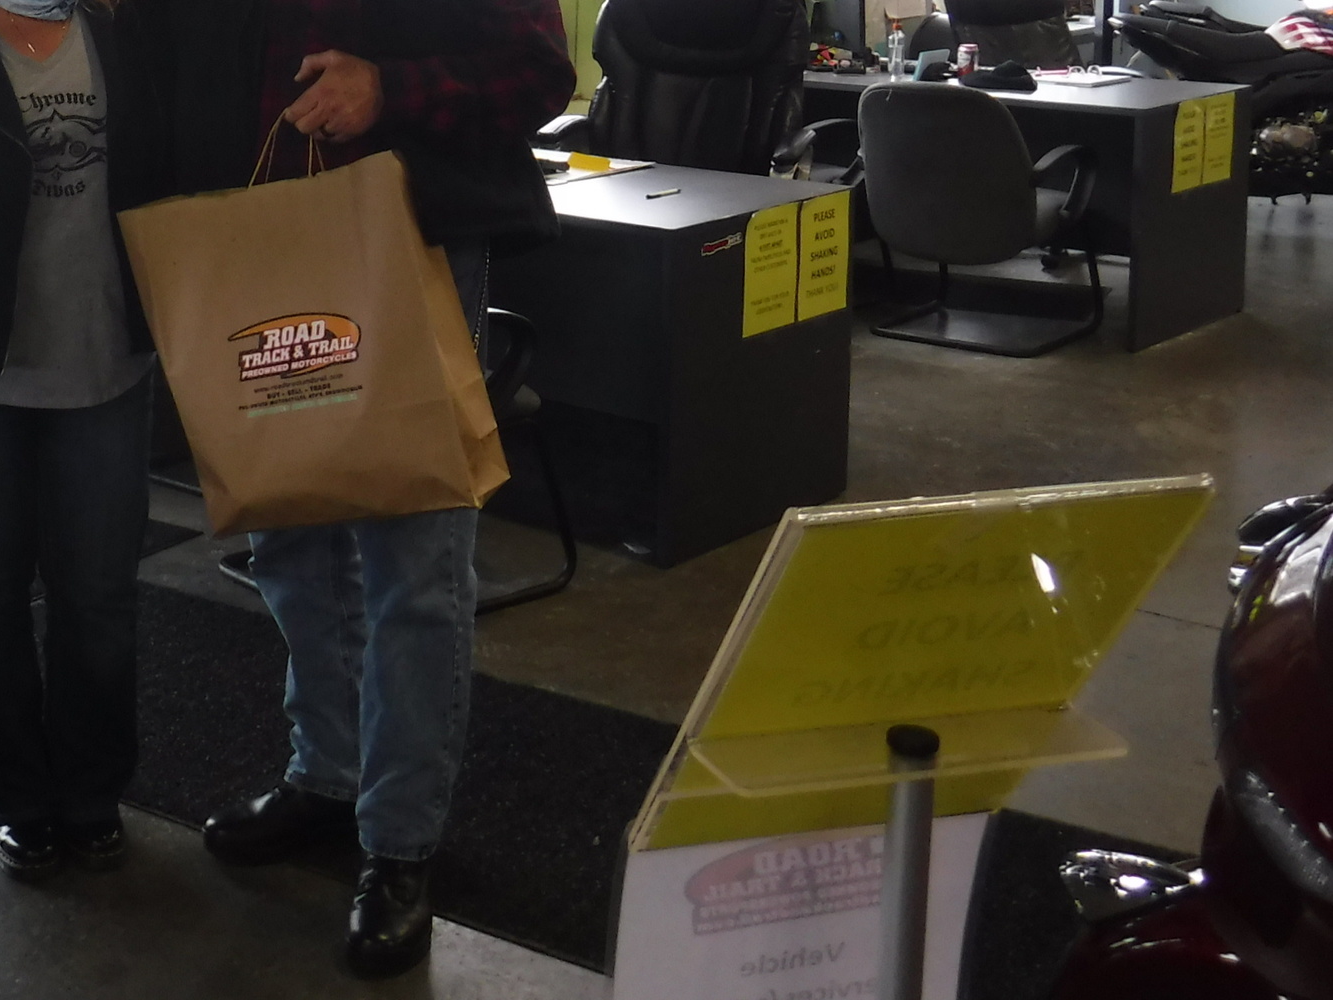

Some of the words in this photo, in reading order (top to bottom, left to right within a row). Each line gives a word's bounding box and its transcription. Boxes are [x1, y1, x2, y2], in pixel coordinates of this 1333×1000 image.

[813, 208, 836, 223] PLEASE
[814, 227, 836, 242] AVOID
[810, 245, 839, 262] SHAKING
[263, 319, 326, 350] ROAD
[241, 346, 291, 369] TRACK
[292, 344, 304, 359] &
[308, 334, 355, 356] TRAIL
[241, 363, 290, 379] PREOWNED
[290, 350, 357, 370] MOTORCYCLES
